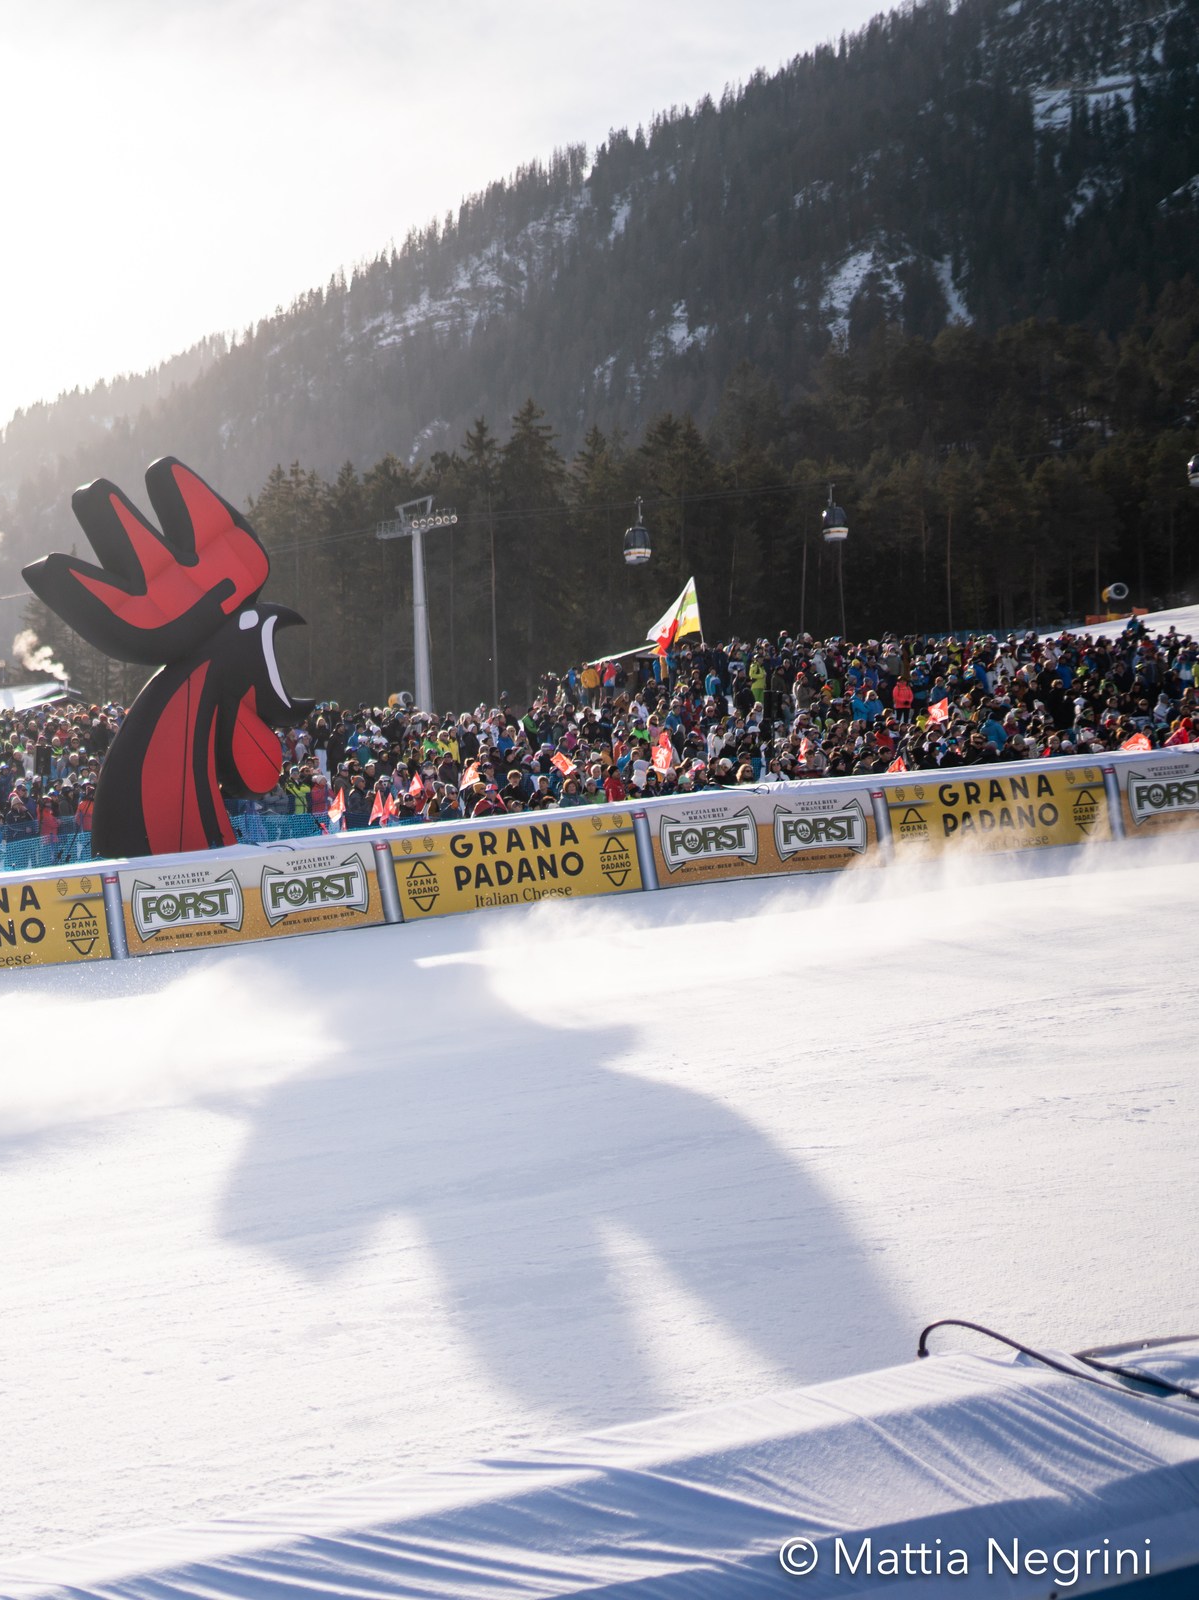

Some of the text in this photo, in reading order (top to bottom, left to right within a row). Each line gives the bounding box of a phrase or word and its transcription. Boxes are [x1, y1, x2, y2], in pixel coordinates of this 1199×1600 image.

[938, 774, 1054, 807] GRANA
[1073, 805, 1100, 814] GRANA
[942, 803, 1059, 837] PADANO
[1073, 812, 1101, 822] PADANO
[782, 815, 859, 845] FORST
[899, 823, 928, 832] GRANA
[450, 821, 579, 859] GRANA
[669, 823, 750, 857] FORST
[286, 854, 337, 867] SPEZIALBIER-
[600, 853, 631, 863] GRANA
[292, 861, 331, 872] BRAUEREI
[454, 851, 584, 892] PADANO
[601, 860, 632, 871] PADANO
[157, 870, 213, 882] SPEZIALBIER-
[164, 876, 206, 887] BRAUEREI
[406, 877, 438, 887] GRANA
[270, 870, 358, 908] FORST
[407, 885, 439, 896] PADANO
[475, 884, 573, 908] Italian Cheese
[142, 887, 233, 924] FORST
[64, 920, 98, 930] GRANA
[65, 927, 99, 939] PADANO
